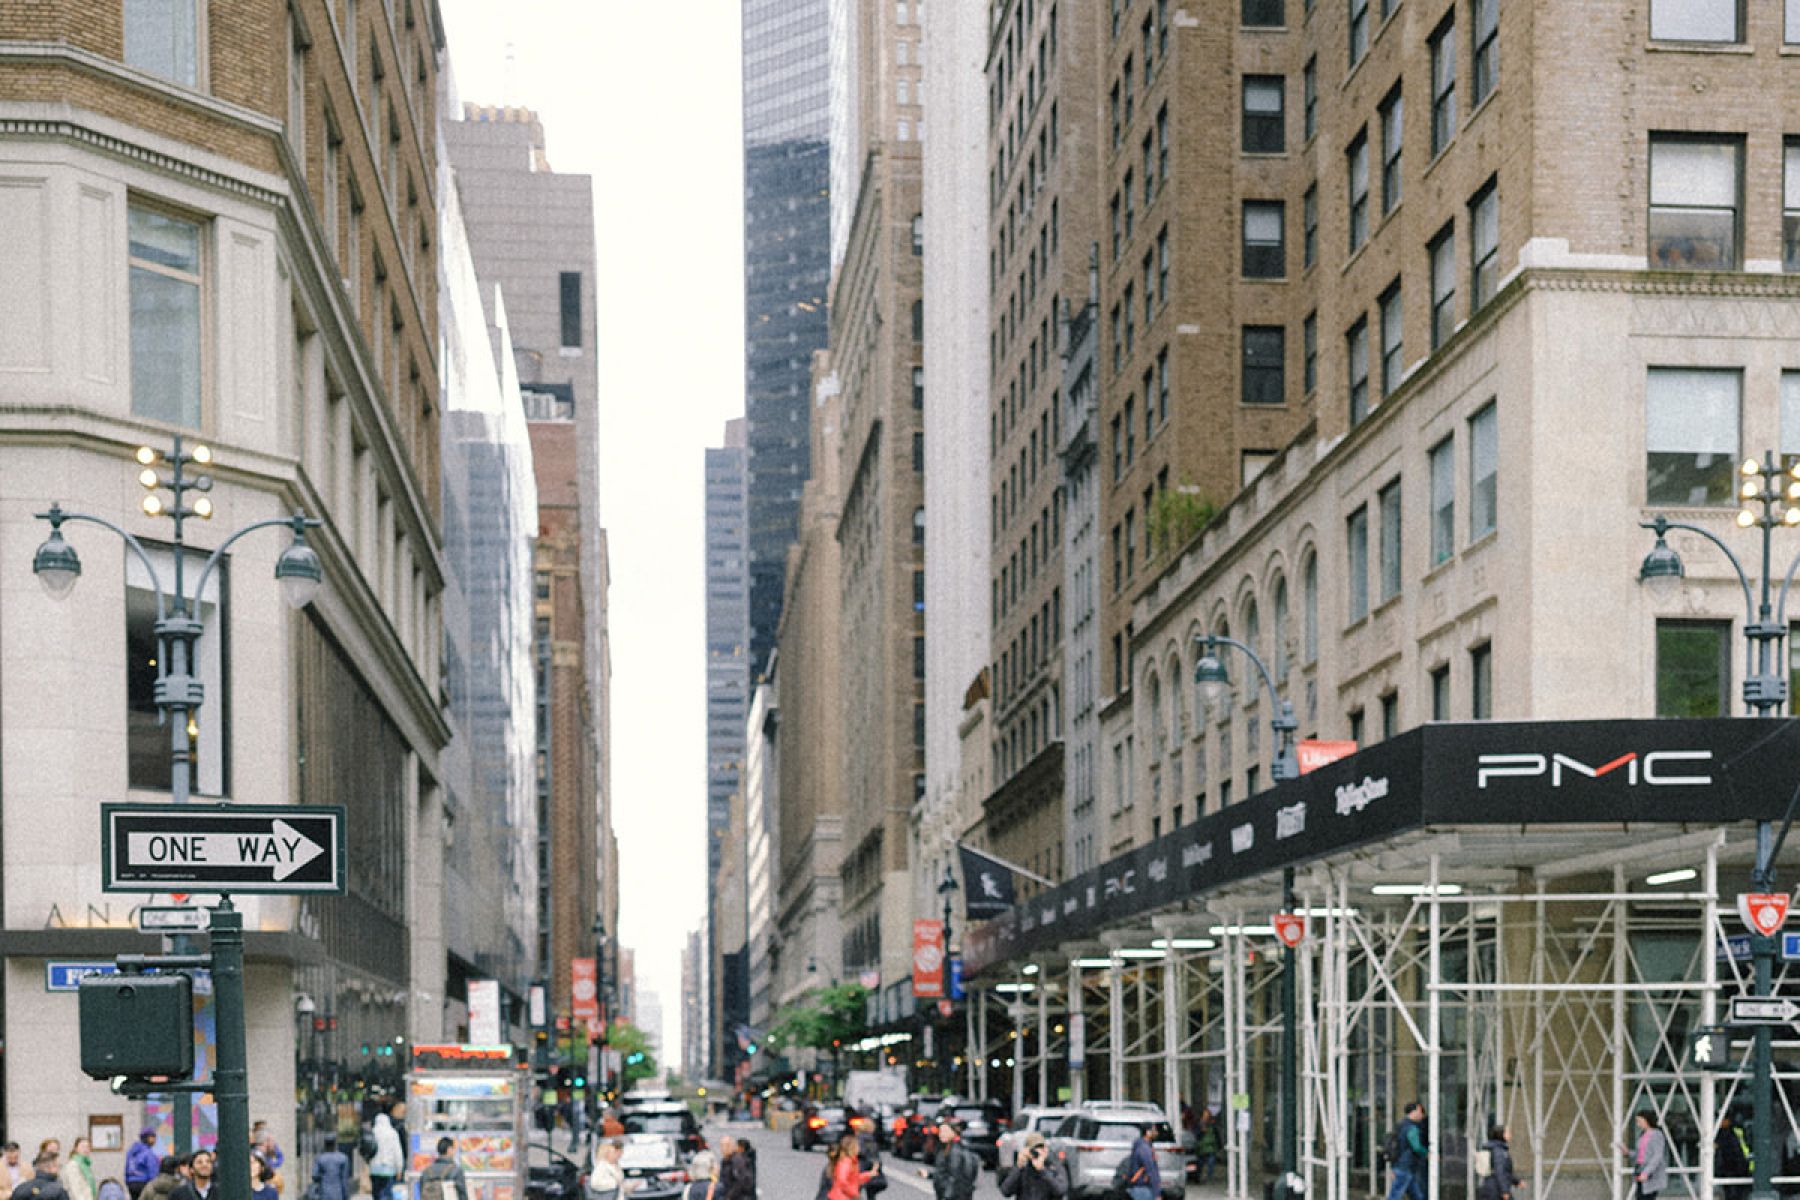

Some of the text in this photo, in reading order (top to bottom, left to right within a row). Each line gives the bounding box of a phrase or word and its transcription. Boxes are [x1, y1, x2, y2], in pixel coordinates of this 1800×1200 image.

[1478, 750, 1713, 788] PMC
[149, 836, 301, 863] ONE WAY
